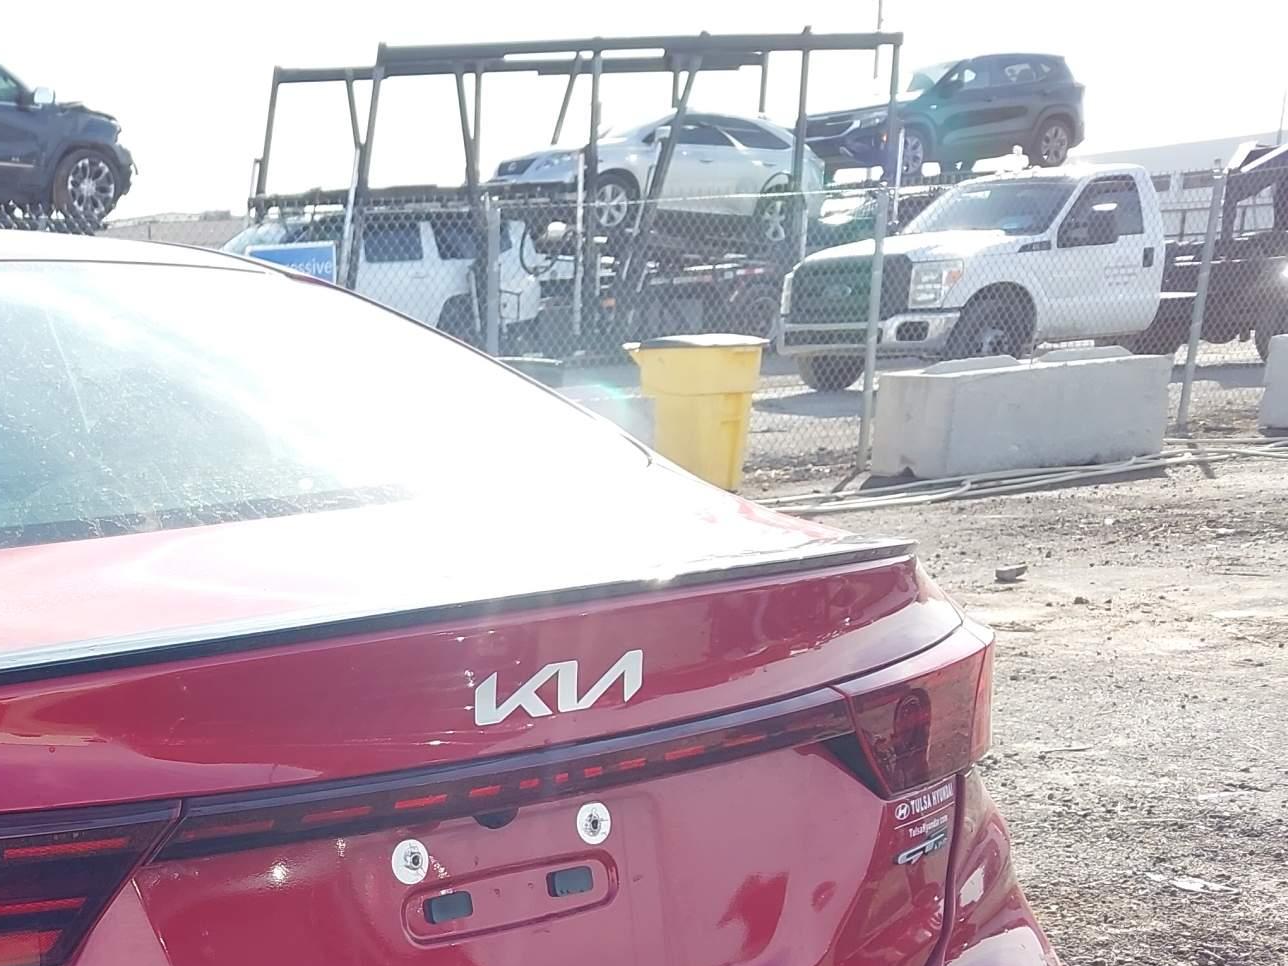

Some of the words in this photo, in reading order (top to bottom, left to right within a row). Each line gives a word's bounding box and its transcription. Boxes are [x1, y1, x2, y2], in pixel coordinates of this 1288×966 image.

[474, 649, 643, 726] KIA
[909, 793, 932, 815] TULSA
[931, 782, 954, 806] HYUNDAI
